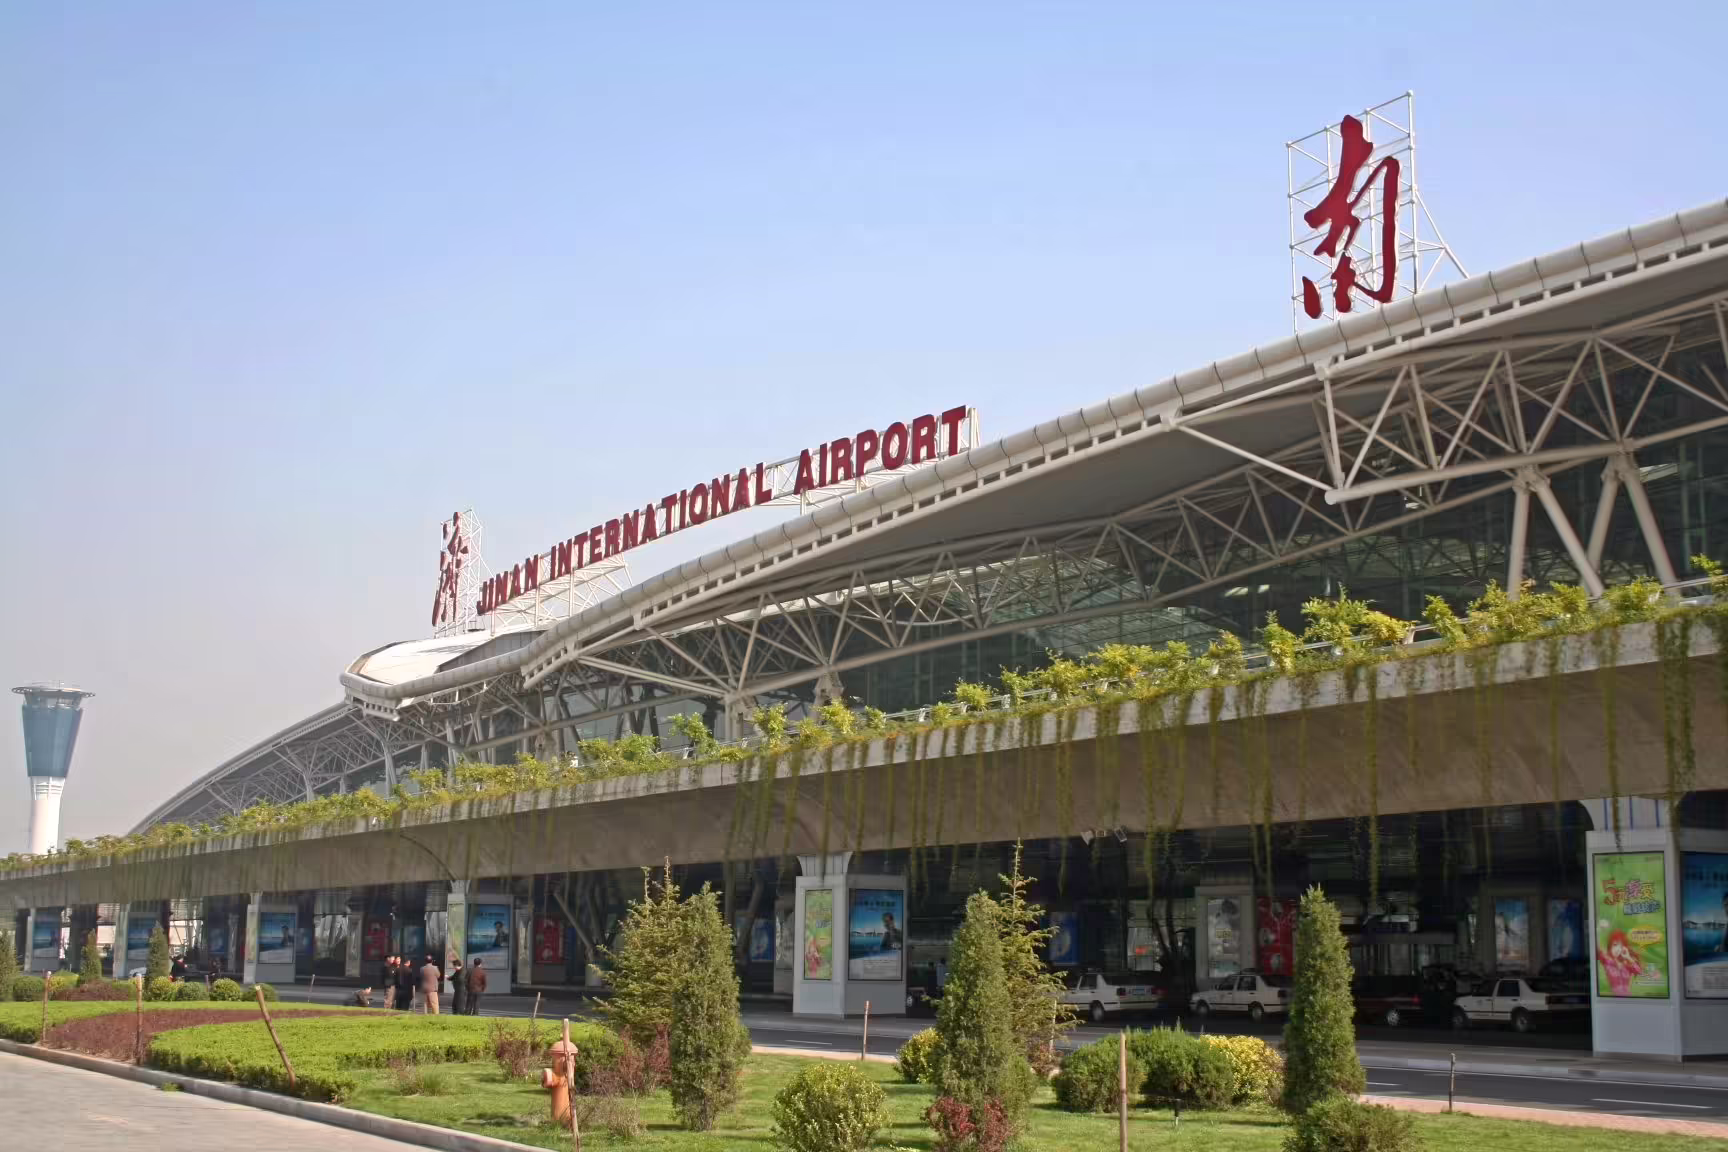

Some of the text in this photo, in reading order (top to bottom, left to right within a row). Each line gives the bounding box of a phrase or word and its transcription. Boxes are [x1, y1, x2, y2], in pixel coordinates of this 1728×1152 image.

[1302, 114, 1400, 319] 南
[476, 405, 967, 616] JINAN INTERNATIONAL AIRPORT
